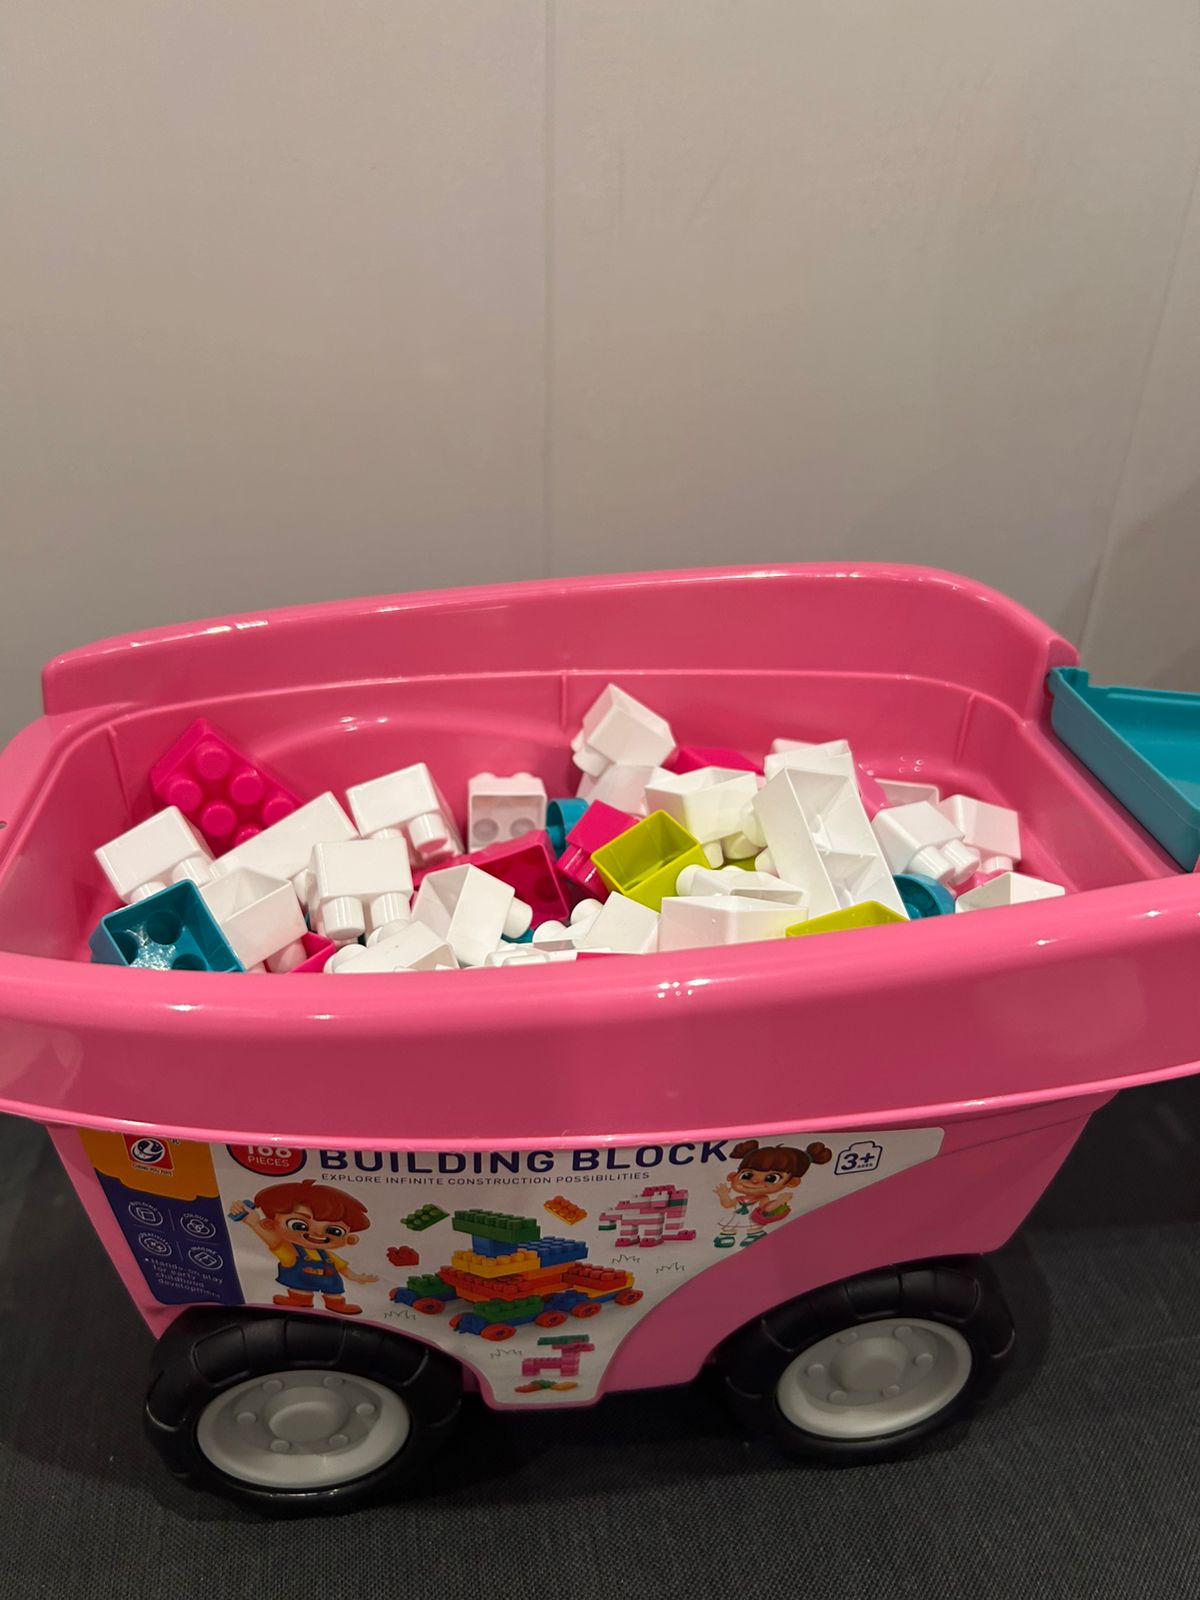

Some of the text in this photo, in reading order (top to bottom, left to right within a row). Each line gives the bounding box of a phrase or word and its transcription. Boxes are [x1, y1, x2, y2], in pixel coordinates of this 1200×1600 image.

[247, 1155, 290, 1168] PIECES
[319, 1140, 729, 1174] BUILDING BLOCK
[840, 1152, 875, 1170] 3+
[321, 1171, 651, 1186] EXPLORE INFINITE CONSTRUCTION POSSIBILITIES
[153, 1264, 197, 1281] for early
[155, 1271, 206, 1289] childhood
[202, 1272, 224, 1285] play
[157, 1277, 222, 1299] development
